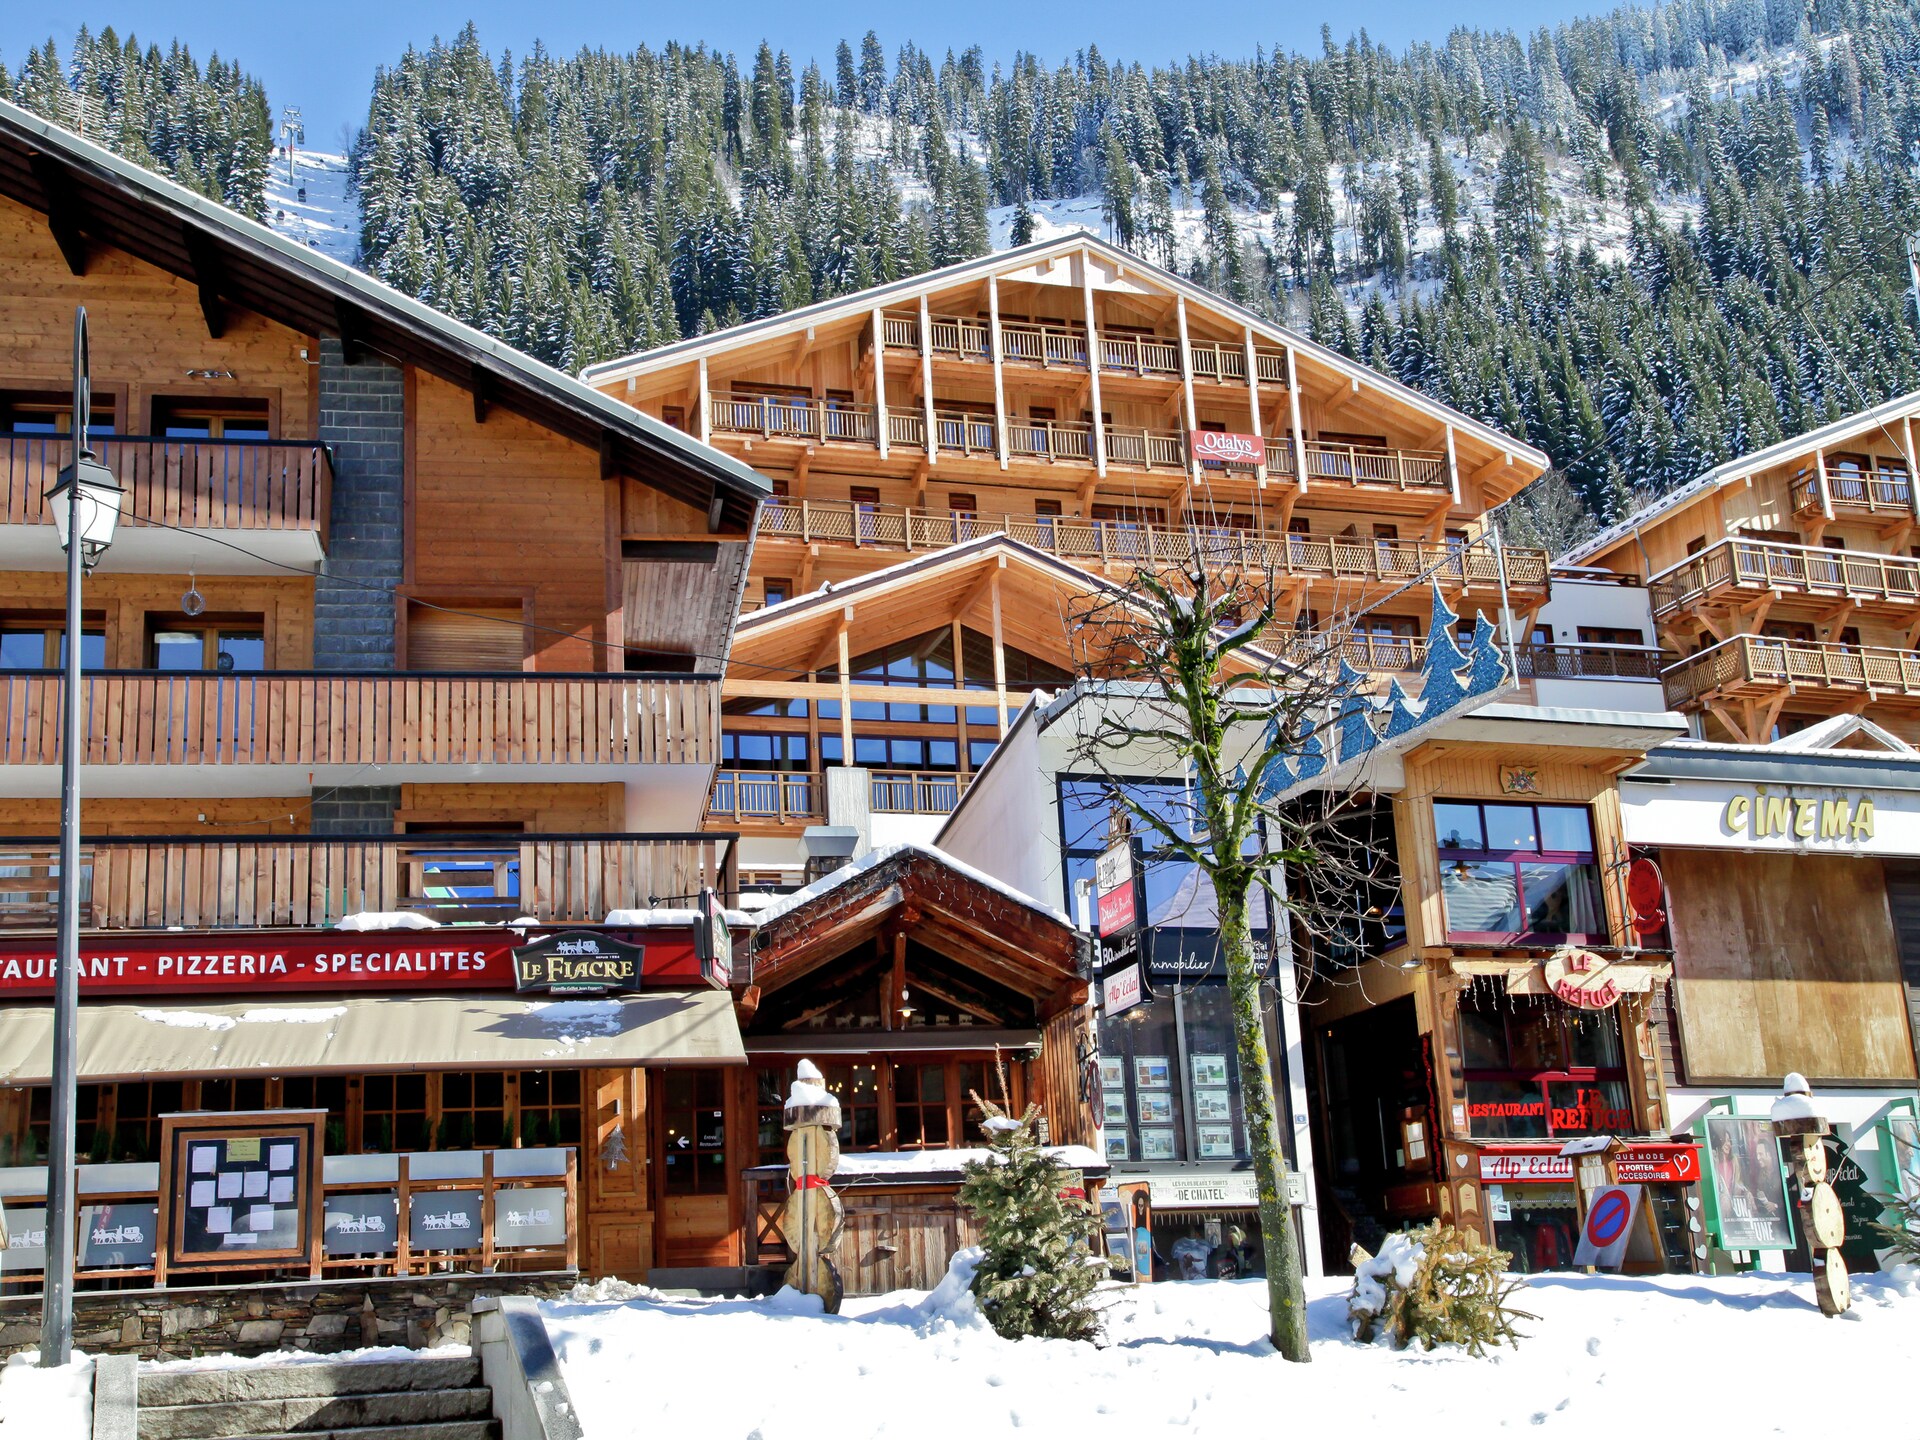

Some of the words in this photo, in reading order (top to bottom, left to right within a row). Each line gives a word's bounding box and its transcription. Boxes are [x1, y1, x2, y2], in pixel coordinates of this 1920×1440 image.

[1203, 432, 1252, 456] Odalys
[1726, 784, 1875, 838] CINEMA
[0, 956, 128, 979] AUANT
[158, 954, 287, 976] PIZZERIA
[314, 951, 486, 973] SPECIALITES
[1150, 951, 1211, 970] mmobilier
[1569, 953, 1593, 972] LE
[1557, 978, 1622, 1008] REFUGE
[1576, 1089, 1604, 1109] LE
[1468, 1102, 1545, 1117] RESTAURANT
[1552, 1108, 1632, 1129] REFUGE
[1618, 1171, 1670, 1180] ACCESSOIRES
[1178, 1189, 1190, 1201] DE
[1191, 1188, 1225, 1201] CHATEL
